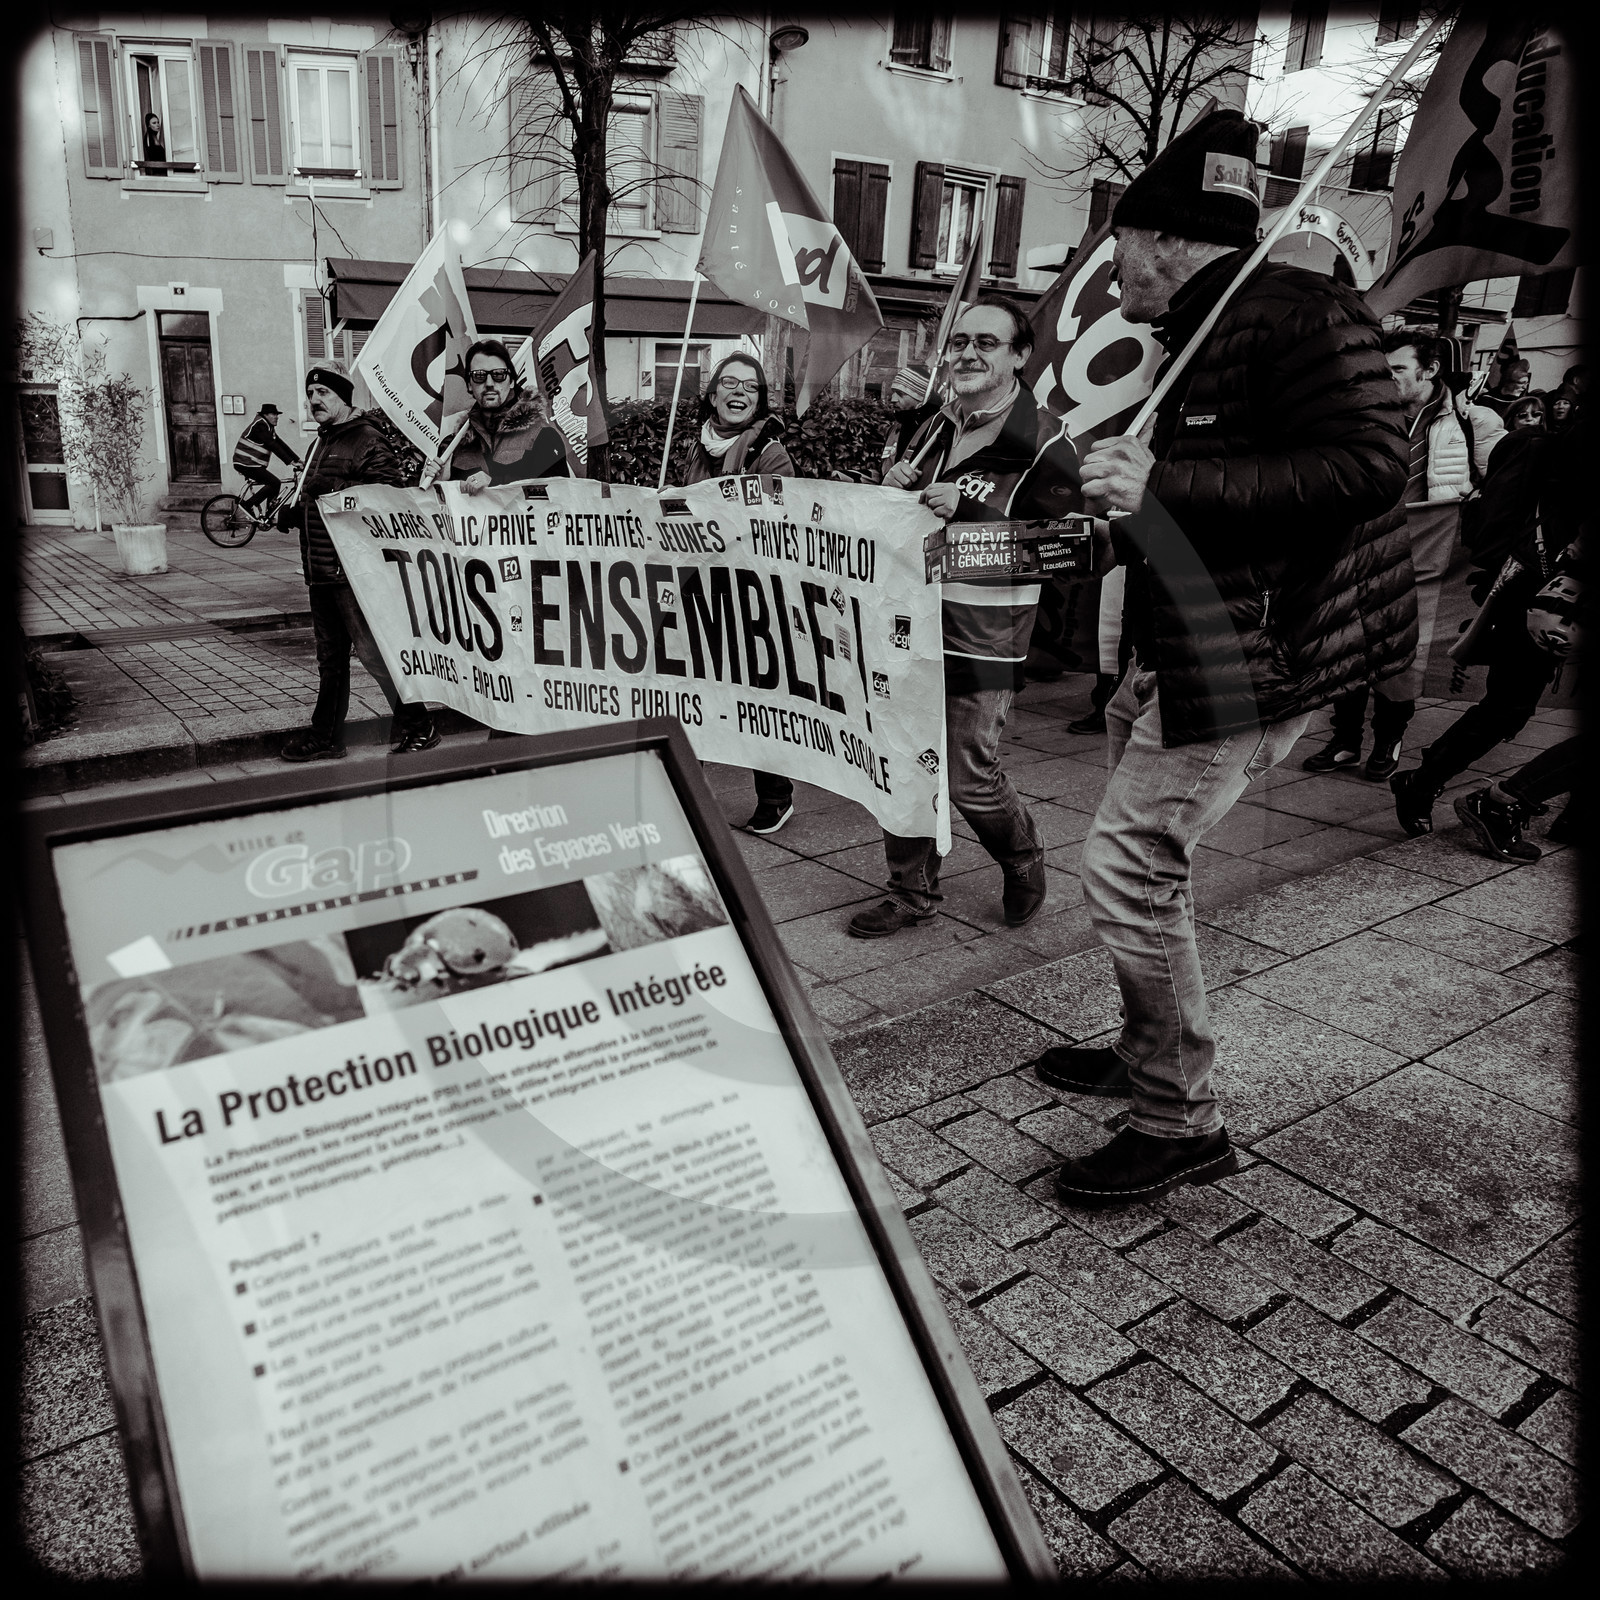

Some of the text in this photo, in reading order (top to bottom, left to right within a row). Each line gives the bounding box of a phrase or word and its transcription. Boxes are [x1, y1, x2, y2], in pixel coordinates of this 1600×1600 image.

[1510, 28, 1563, 214] ducation
[371, 364, 405, 409] Fédération
[540, 355, 562, 400] force
[746, 480, 760, 499] FO
[955, 471, 996, 503] cgt
[362, 509, 432, 540] SALARIÉS
[655, 522, 727, 554] JEUNES
[750, 514, 799, 563] PRIVÉS
[805, 526, 876, 584] D'EMPLOI
[957, 527, 1010, 553] GRÈVE
[957, 551, 1012, 568] GÉNÉRALE
[503, 559, 518, 577] FO
[381, 548, 504, 662] TOUS
[530, 557, 847, 716] ENSEMBLE
[895, 634, 910, 649] cgt
[400, 650, 459, 685] SALAIRES
[472, 665, 515, 704] EMPLOI
[543, 679, 621, 717] SERVICES
[631, 687, 704, 727] PUBLICS
[737, 701, 836, 757] PROTECTION
[873, 679, 890, 693] cgt
[483, 804, 570, 839] Direction
[245, 837, 412, 898] Gap
[498, 821, 663, 875] des Espaces Verts
[155, 963, 727, 1145] La Protection Biologique Intégrée
